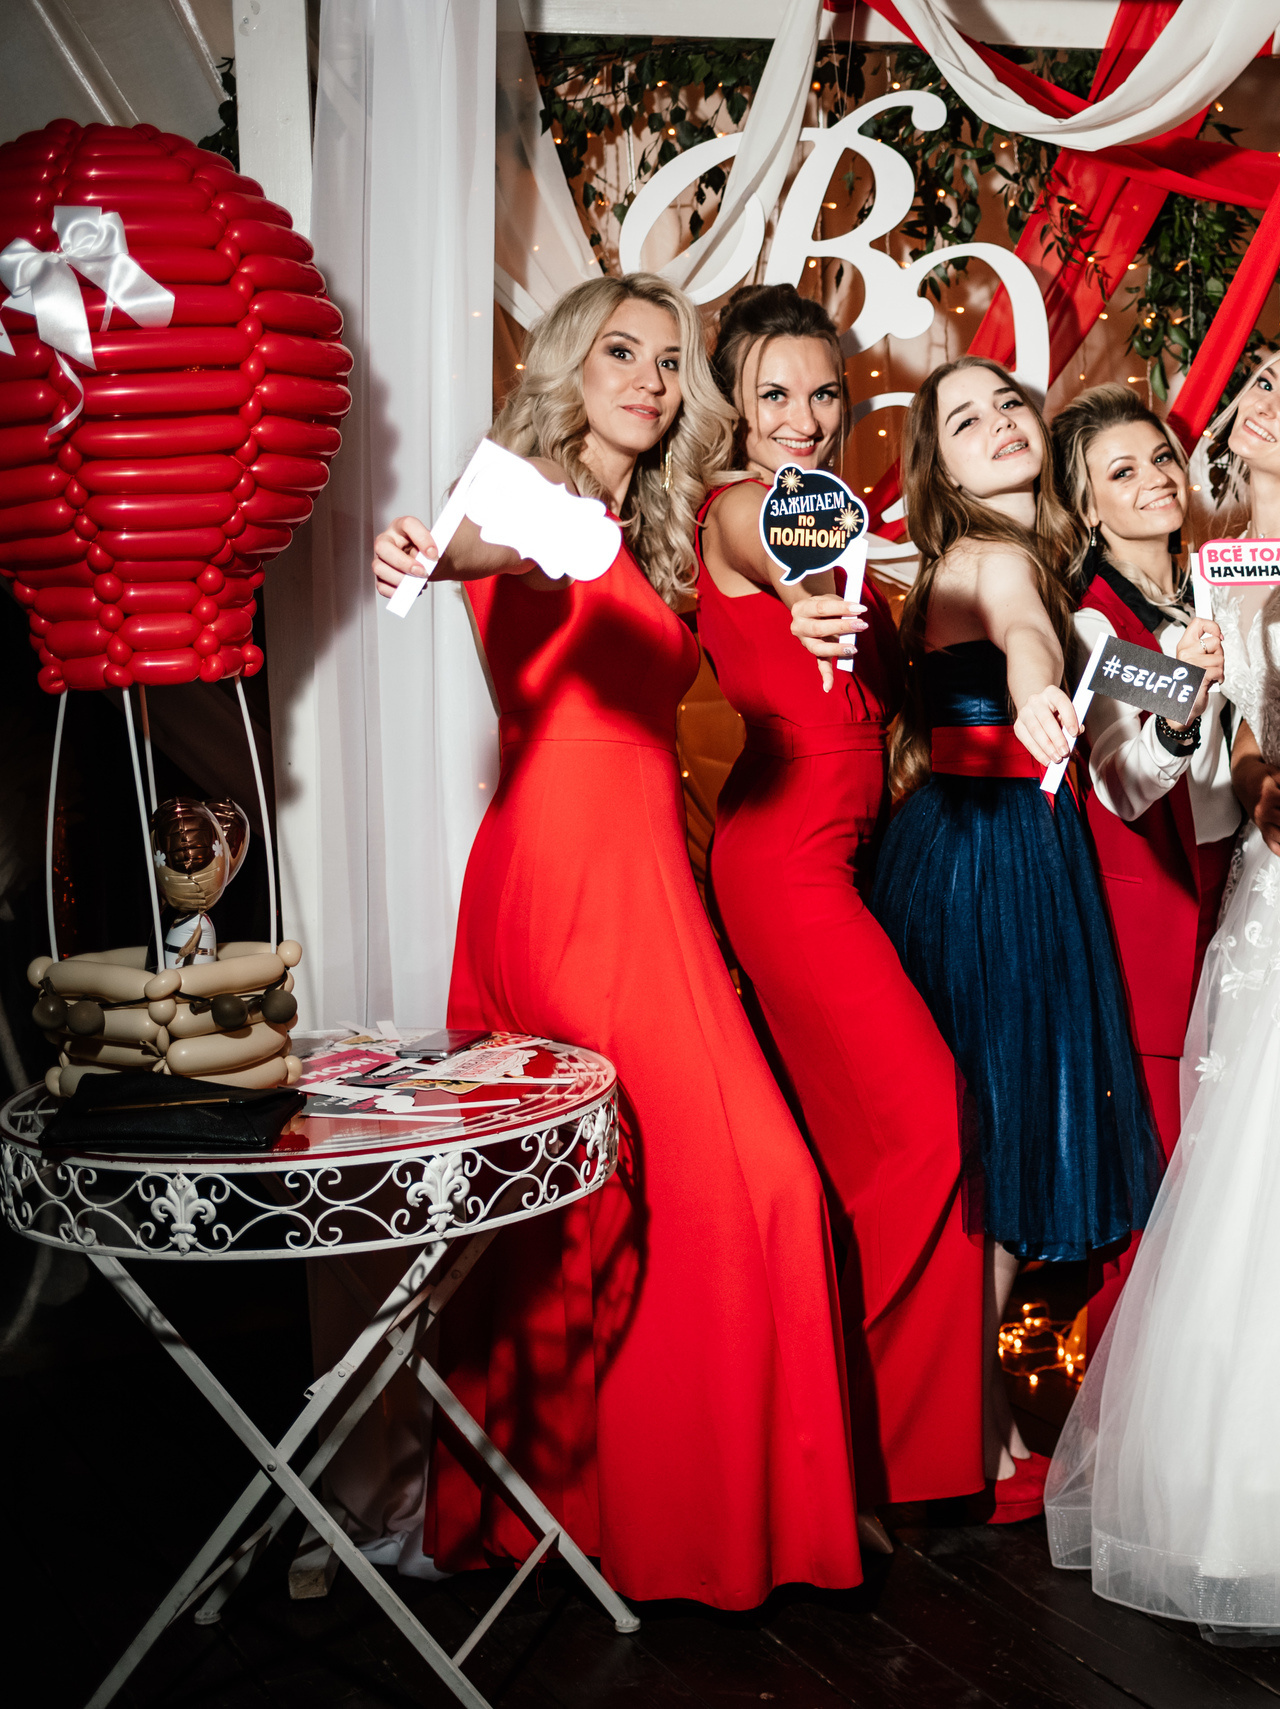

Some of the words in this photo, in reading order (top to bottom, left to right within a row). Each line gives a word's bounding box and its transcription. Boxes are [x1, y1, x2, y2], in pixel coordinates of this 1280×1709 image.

[770, 491, 845, 516] ЗАЖИГАЕМ
[769, 526, 847, 549] ПОЛНОЙ!
[1207, 545, 1243, 563] ВСЁ
